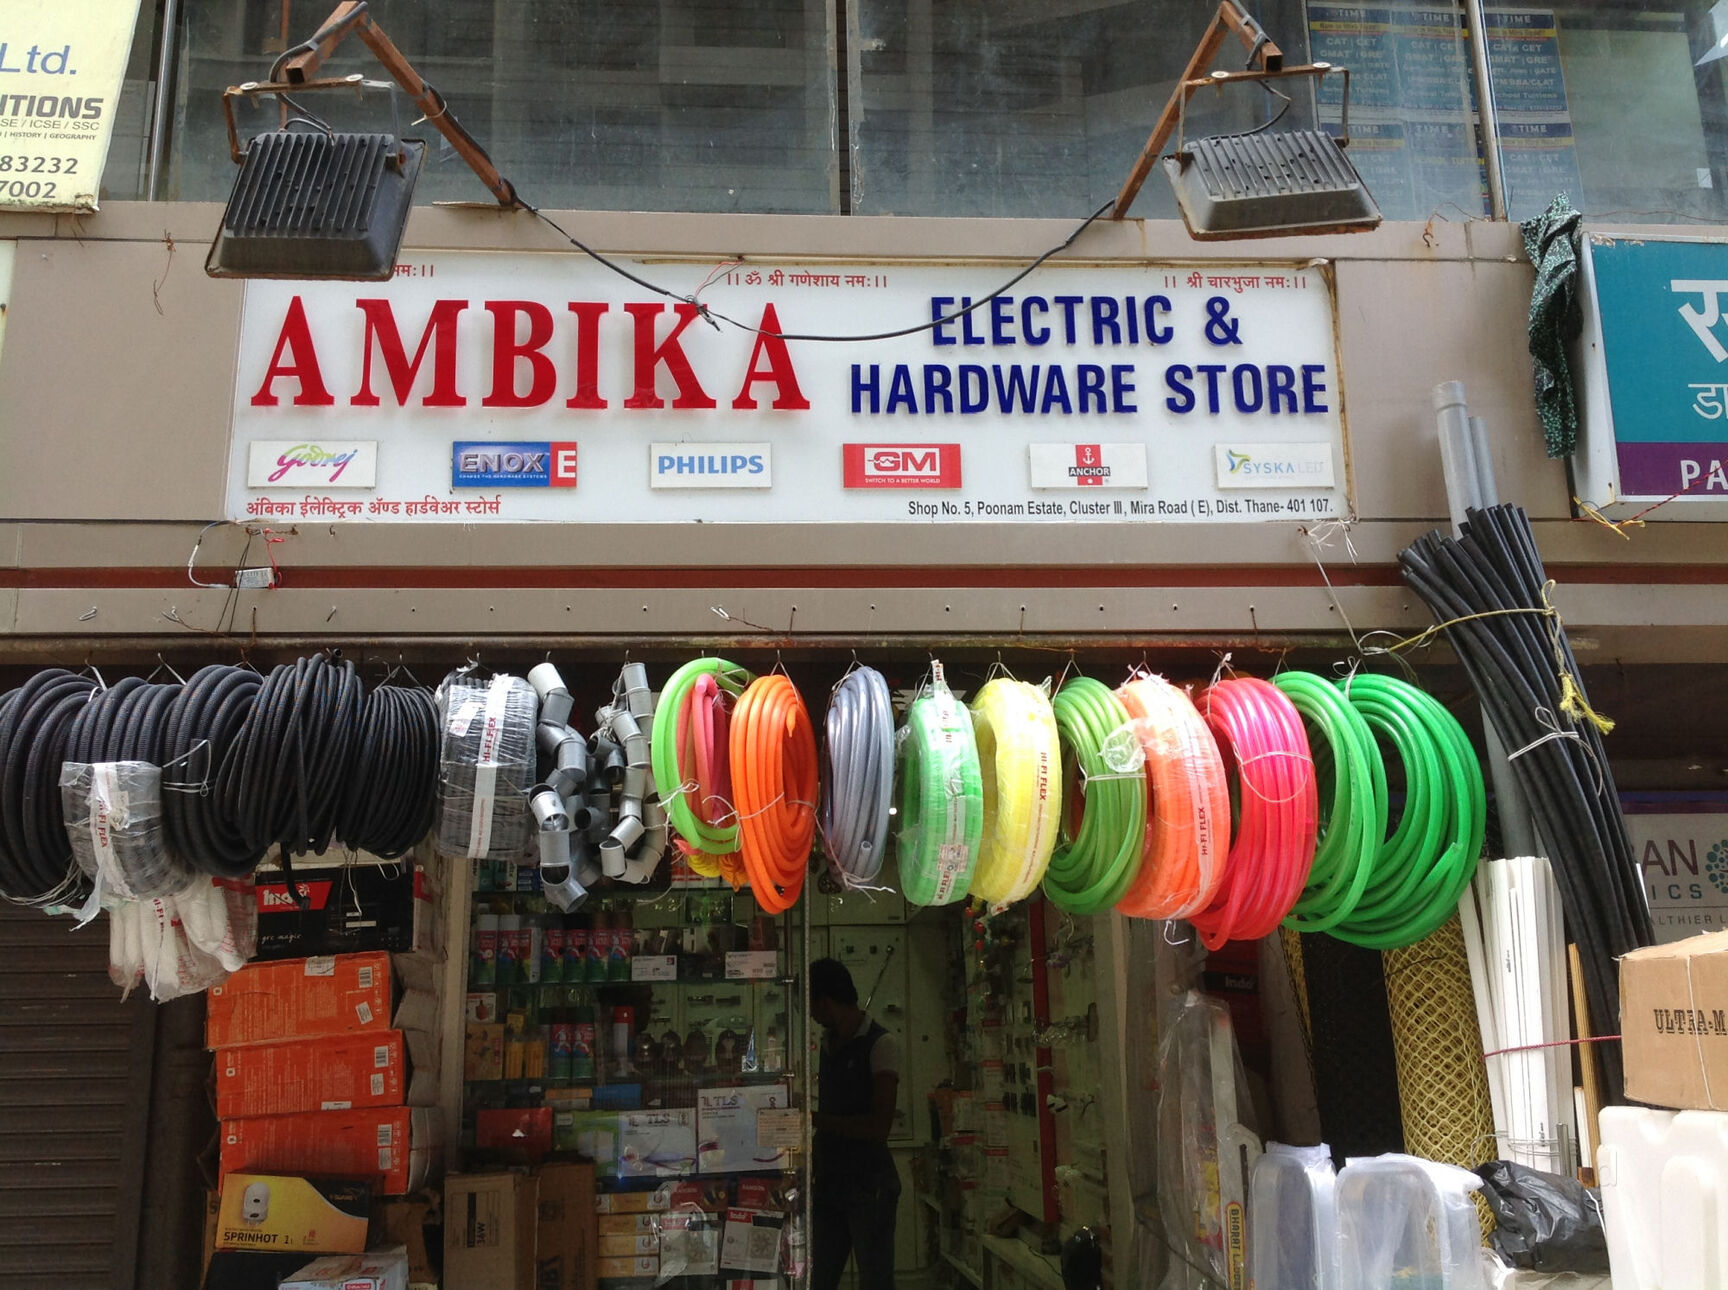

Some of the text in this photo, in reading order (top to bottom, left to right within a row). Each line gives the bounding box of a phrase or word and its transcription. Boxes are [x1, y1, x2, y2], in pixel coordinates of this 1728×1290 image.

[0, 42, 77, 75] Ltd.
[0, 94, 104, 120] ITIONS
[30, 120, 61, 129] ICSE
[72, 122, 100, 131] SSC
[0, 155, 78, 174] 83232
[0, 181, 56, 199] 7002
[745, 271, 762, 286] ॐ
[768, 269, 785, 287] श्री
[789, 270, 840, 287] गणेशाय
[1186, 271, 1203, 288] श्री
[1207, 276, 1261, 293] चारभुजा
[931, 295, 1243, 347] ELECTRIC &
[250, 295, 811, 411] AMBIKA
[850, 363, 1329, 415] HARDWARE STORE
[267, 443, 359, 483] Godrej
[460, 452, 546, 474] ENOX
[658, 455, 764, 475] PHILIPS
[867, 451, 937, 472] GM
[1069, 467, 1111, 477] ANCHOR
[1243, 462, 1295, 474] SYSKA
[246, 497, 296, 516] अंबिका
[908, 501, 938, 517] Shop
[942, 501, 961, 515] No.
[964, 501, 975, 517] 5,
[977, 501, 1024, 515] Poonam
[1027, 501, 1067, 517] Estate,
[1070, 500, 1111, 515] Cluster
[1130, 500, 1155, 514] Mira
[1158, 500, 1188, 514] Road
[1216, 500, 1242, 513] Dist.
[1245, 499, 1285, 513] Thane-
[1287, 499, 1306, 512] 401
[1310, 499, 1334, 512] 107.
[1039, 776, 1048, 801] FLEX
[1198, 807, 1208, 856] HI-FI FLEX
[1629, 840, 1699, 876] AN
[1651, 883, 1703, 900] ICS
[223, 1231, 279, 1244] SPRINHOT
